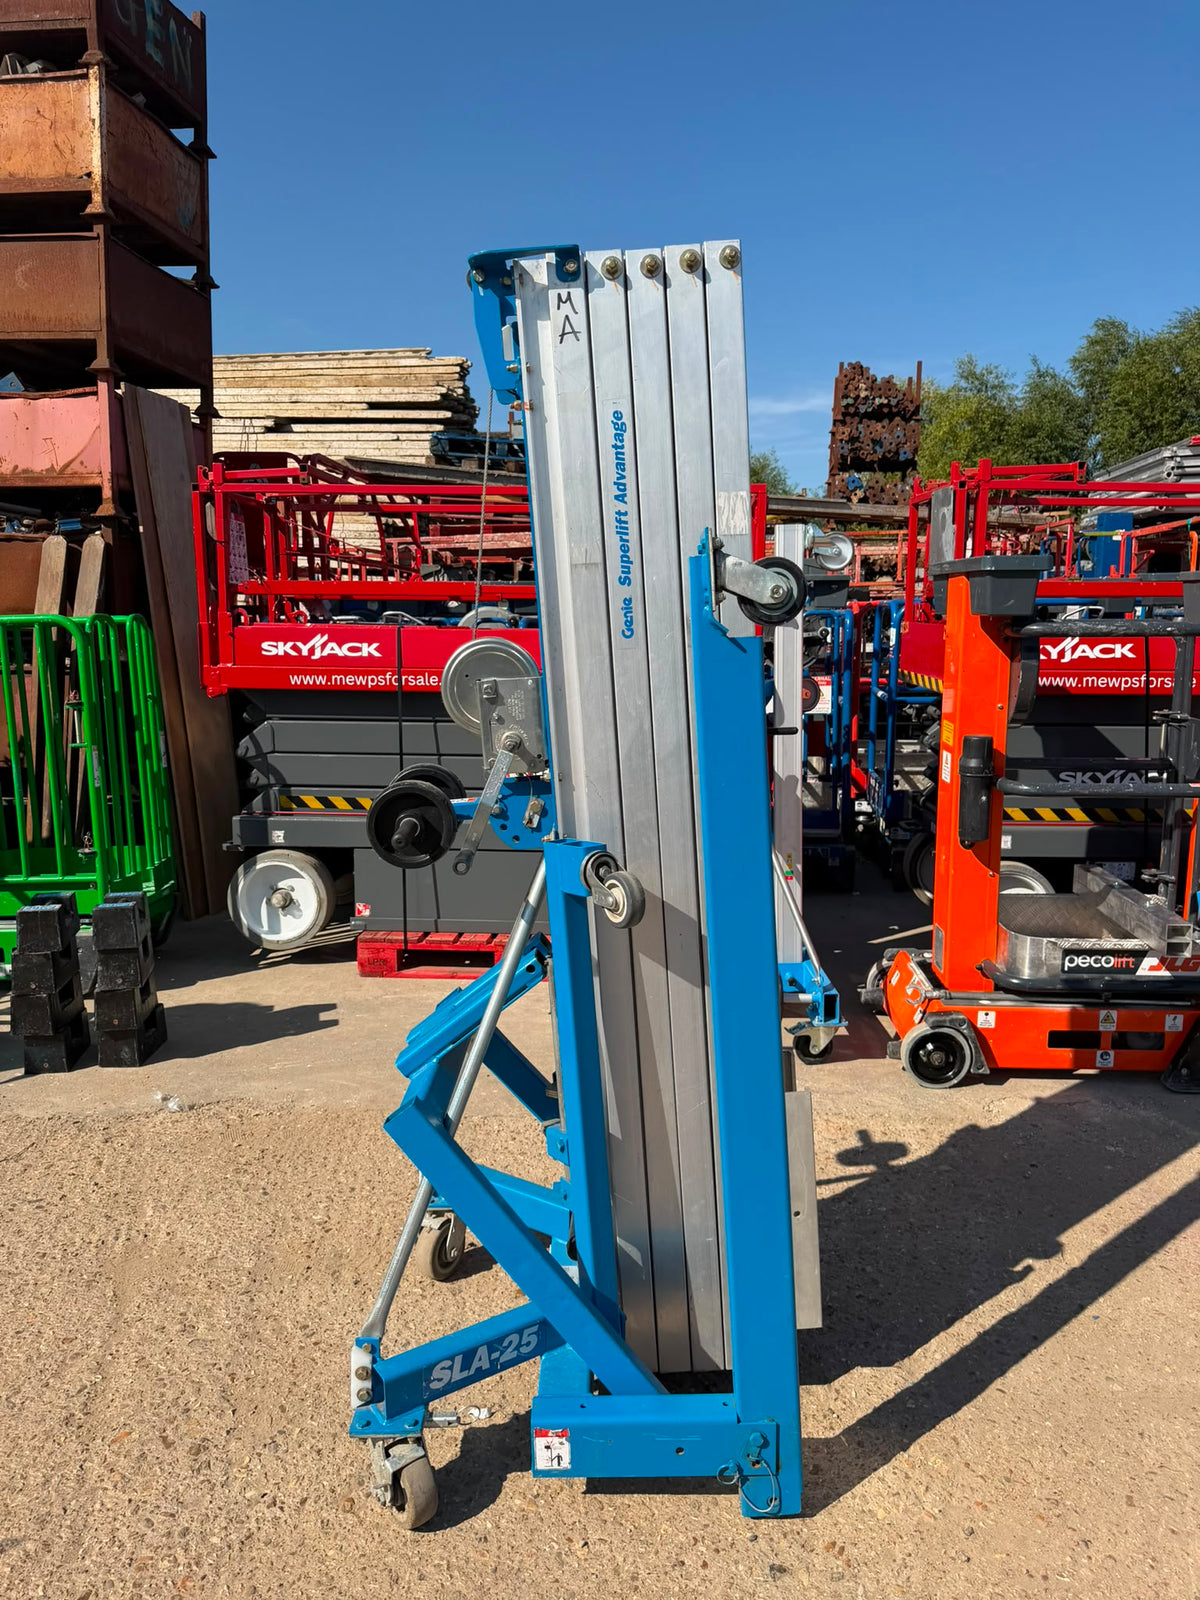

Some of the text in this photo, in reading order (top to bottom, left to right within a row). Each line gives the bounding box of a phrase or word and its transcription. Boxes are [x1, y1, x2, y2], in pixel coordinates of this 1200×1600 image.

[557, 291, 579, 315] M
[558, 314, 582, 344] A
[611, 409, 635, 640] Genie Superlift Advantage
[260, 633, 382, 660] SKYJACK
[1040, 636, 1136, 663] YJACK
[1064, 953, 1135, 971] pecolift
[429, 1324, 540, 1390] SLA-25
